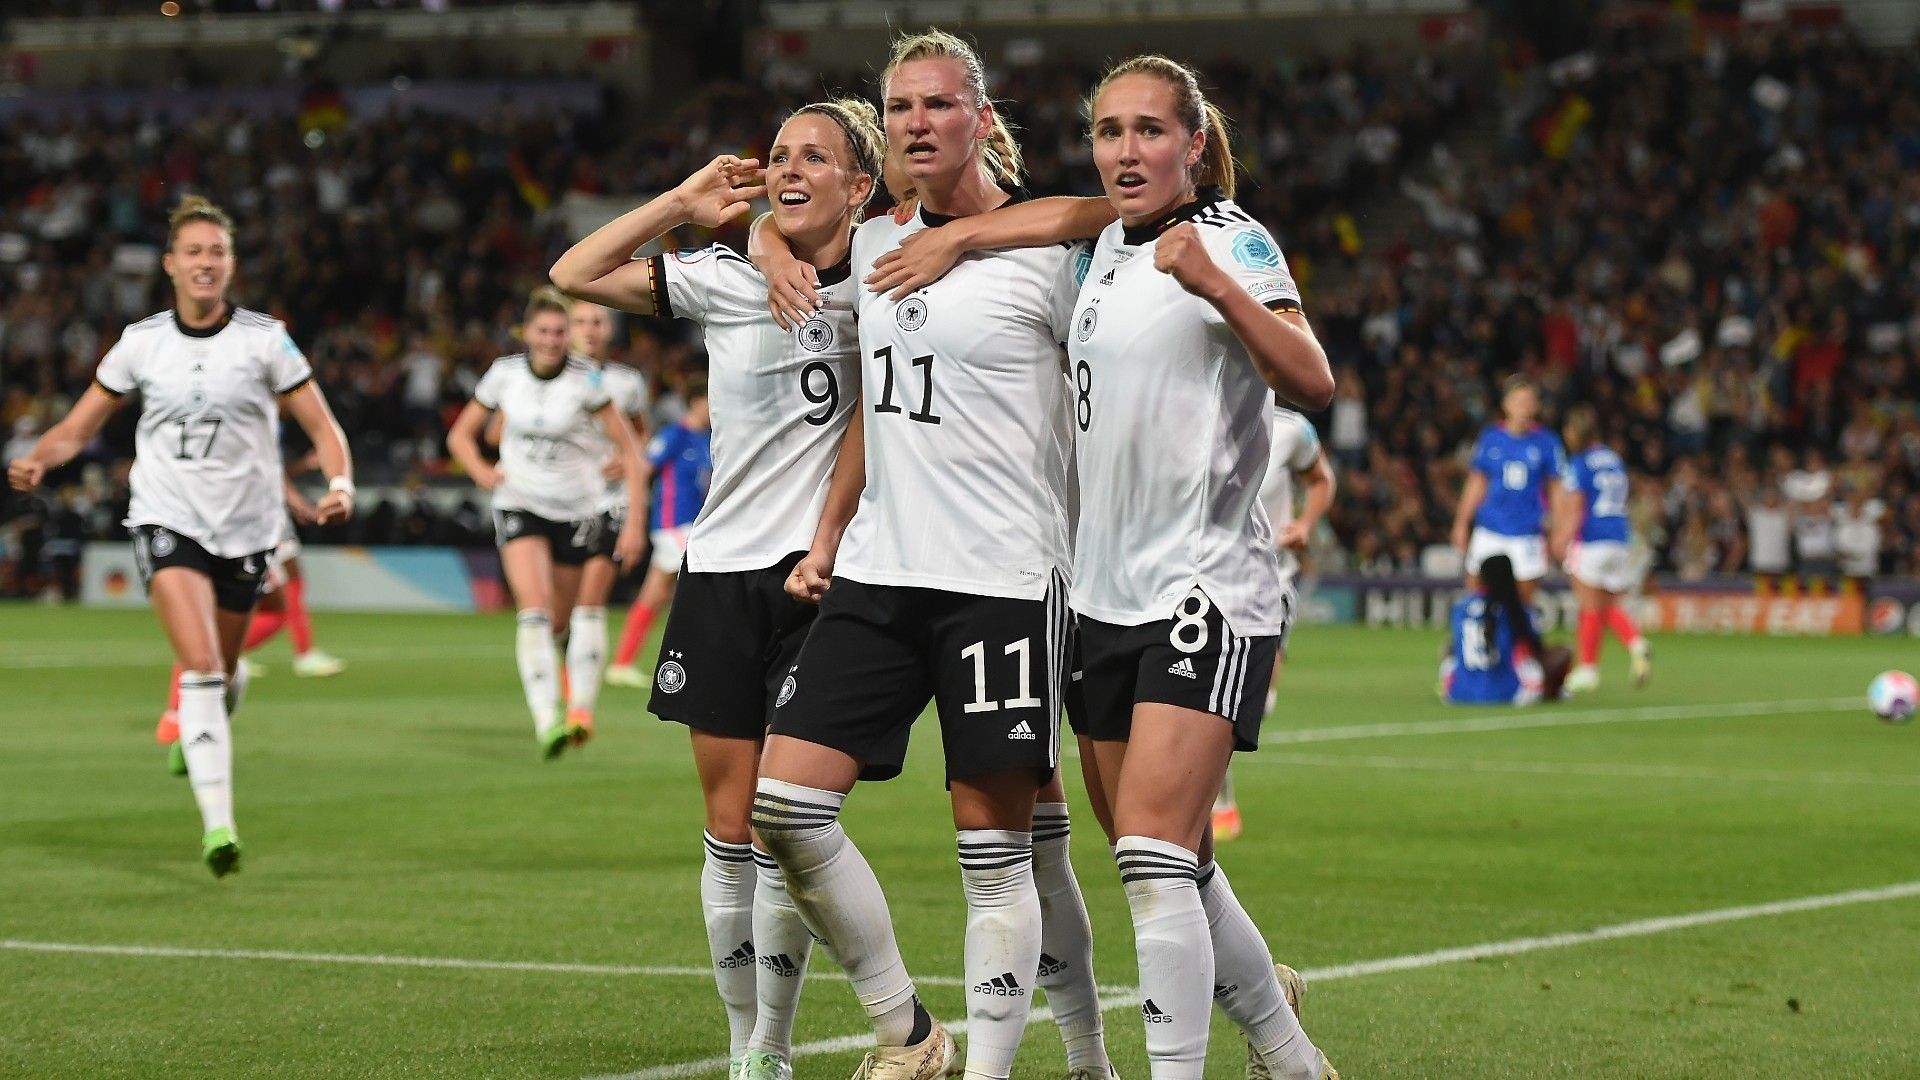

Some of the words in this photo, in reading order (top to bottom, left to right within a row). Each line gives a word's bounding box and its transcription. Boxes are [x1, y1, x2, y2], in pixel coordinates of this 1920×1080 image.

[801, 361, 839, 426] 9
[874, 345, 941, 425] 11
[1077, 360, 1091, 432] 8
[174, 416, 223, 460] 17
[1169, 588, 1210, 653] 8
[961, 637, 1042, 714] 11
[1168, 666, 1197, 680] adidas
[1007, 731, 1036, 740] adidas
[718, 953, 756, 969] adida
[758, 955, 799, 977] adidas
[973, 985, 1025, 997] adidas
